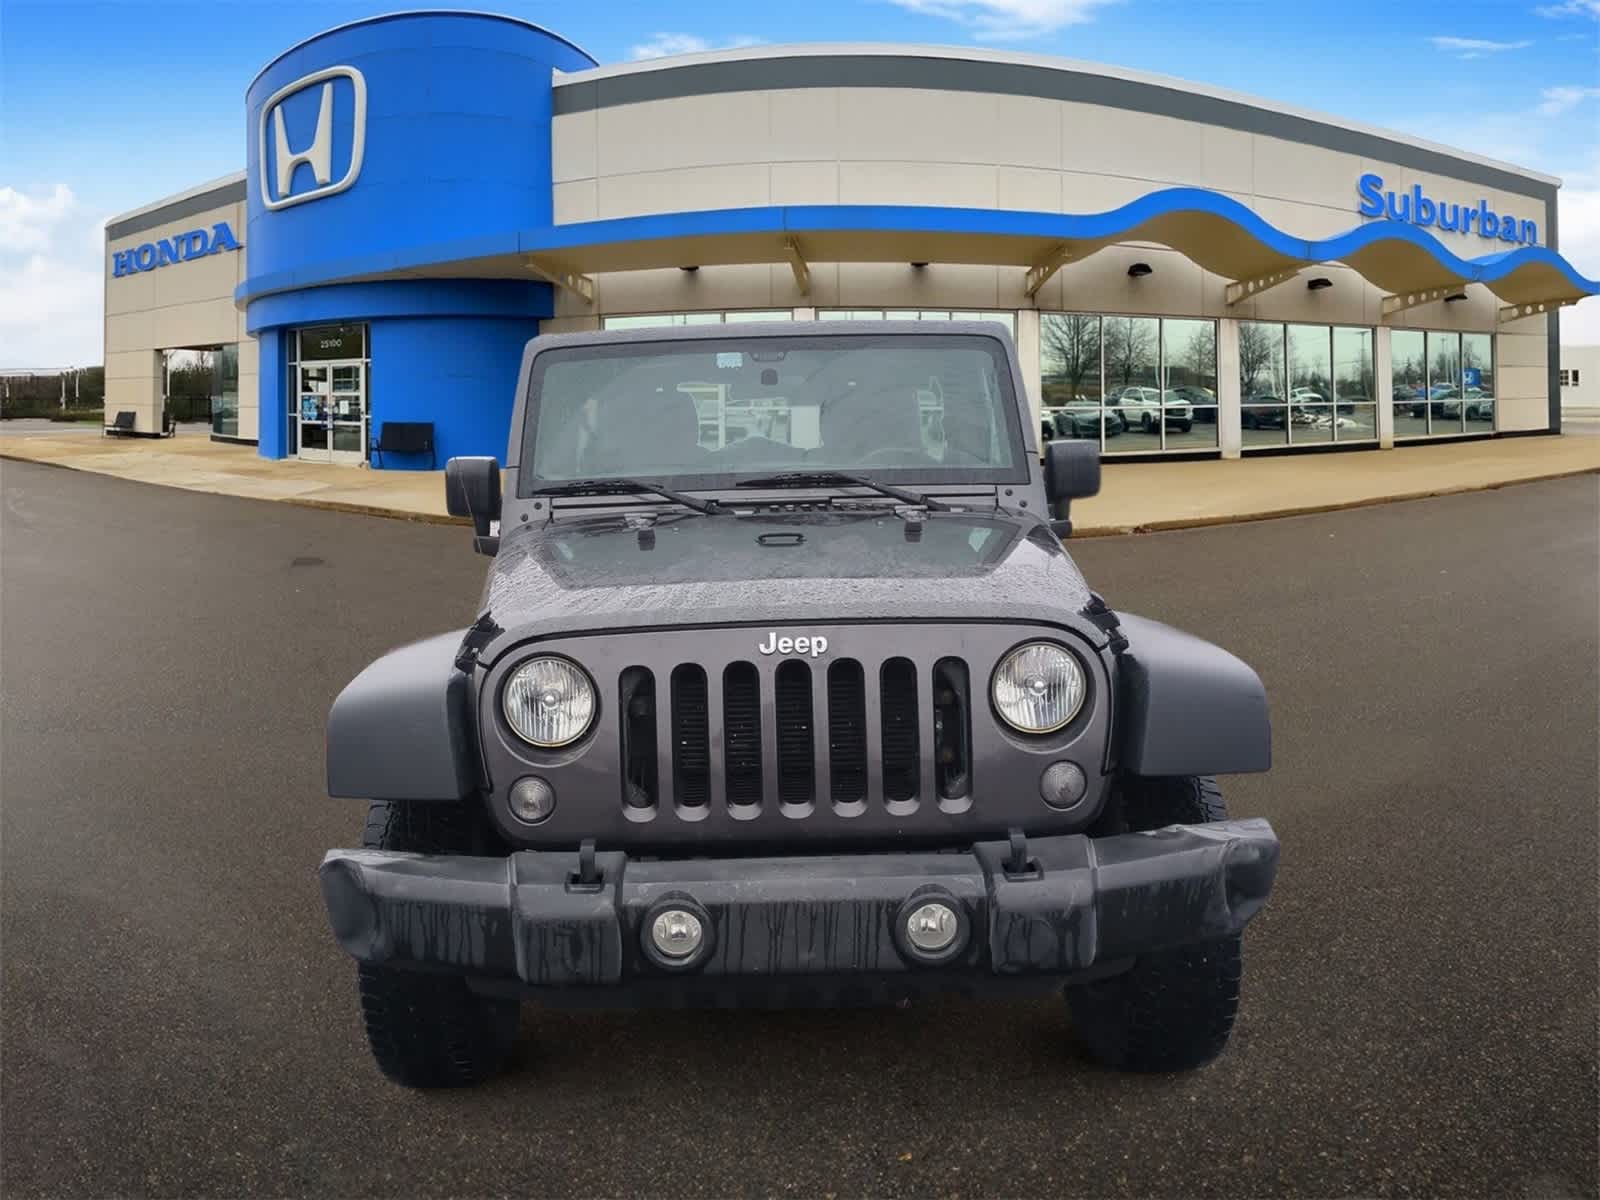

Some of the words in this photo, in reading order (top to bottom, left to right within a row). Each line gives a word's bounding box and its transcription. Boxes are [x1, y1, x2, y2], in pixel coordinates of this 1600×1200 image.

[1357, 173, 1538, 244] Suburban
[112, 221, 240, 278] HONDA
[759, 632, 828, 657] Jeep
